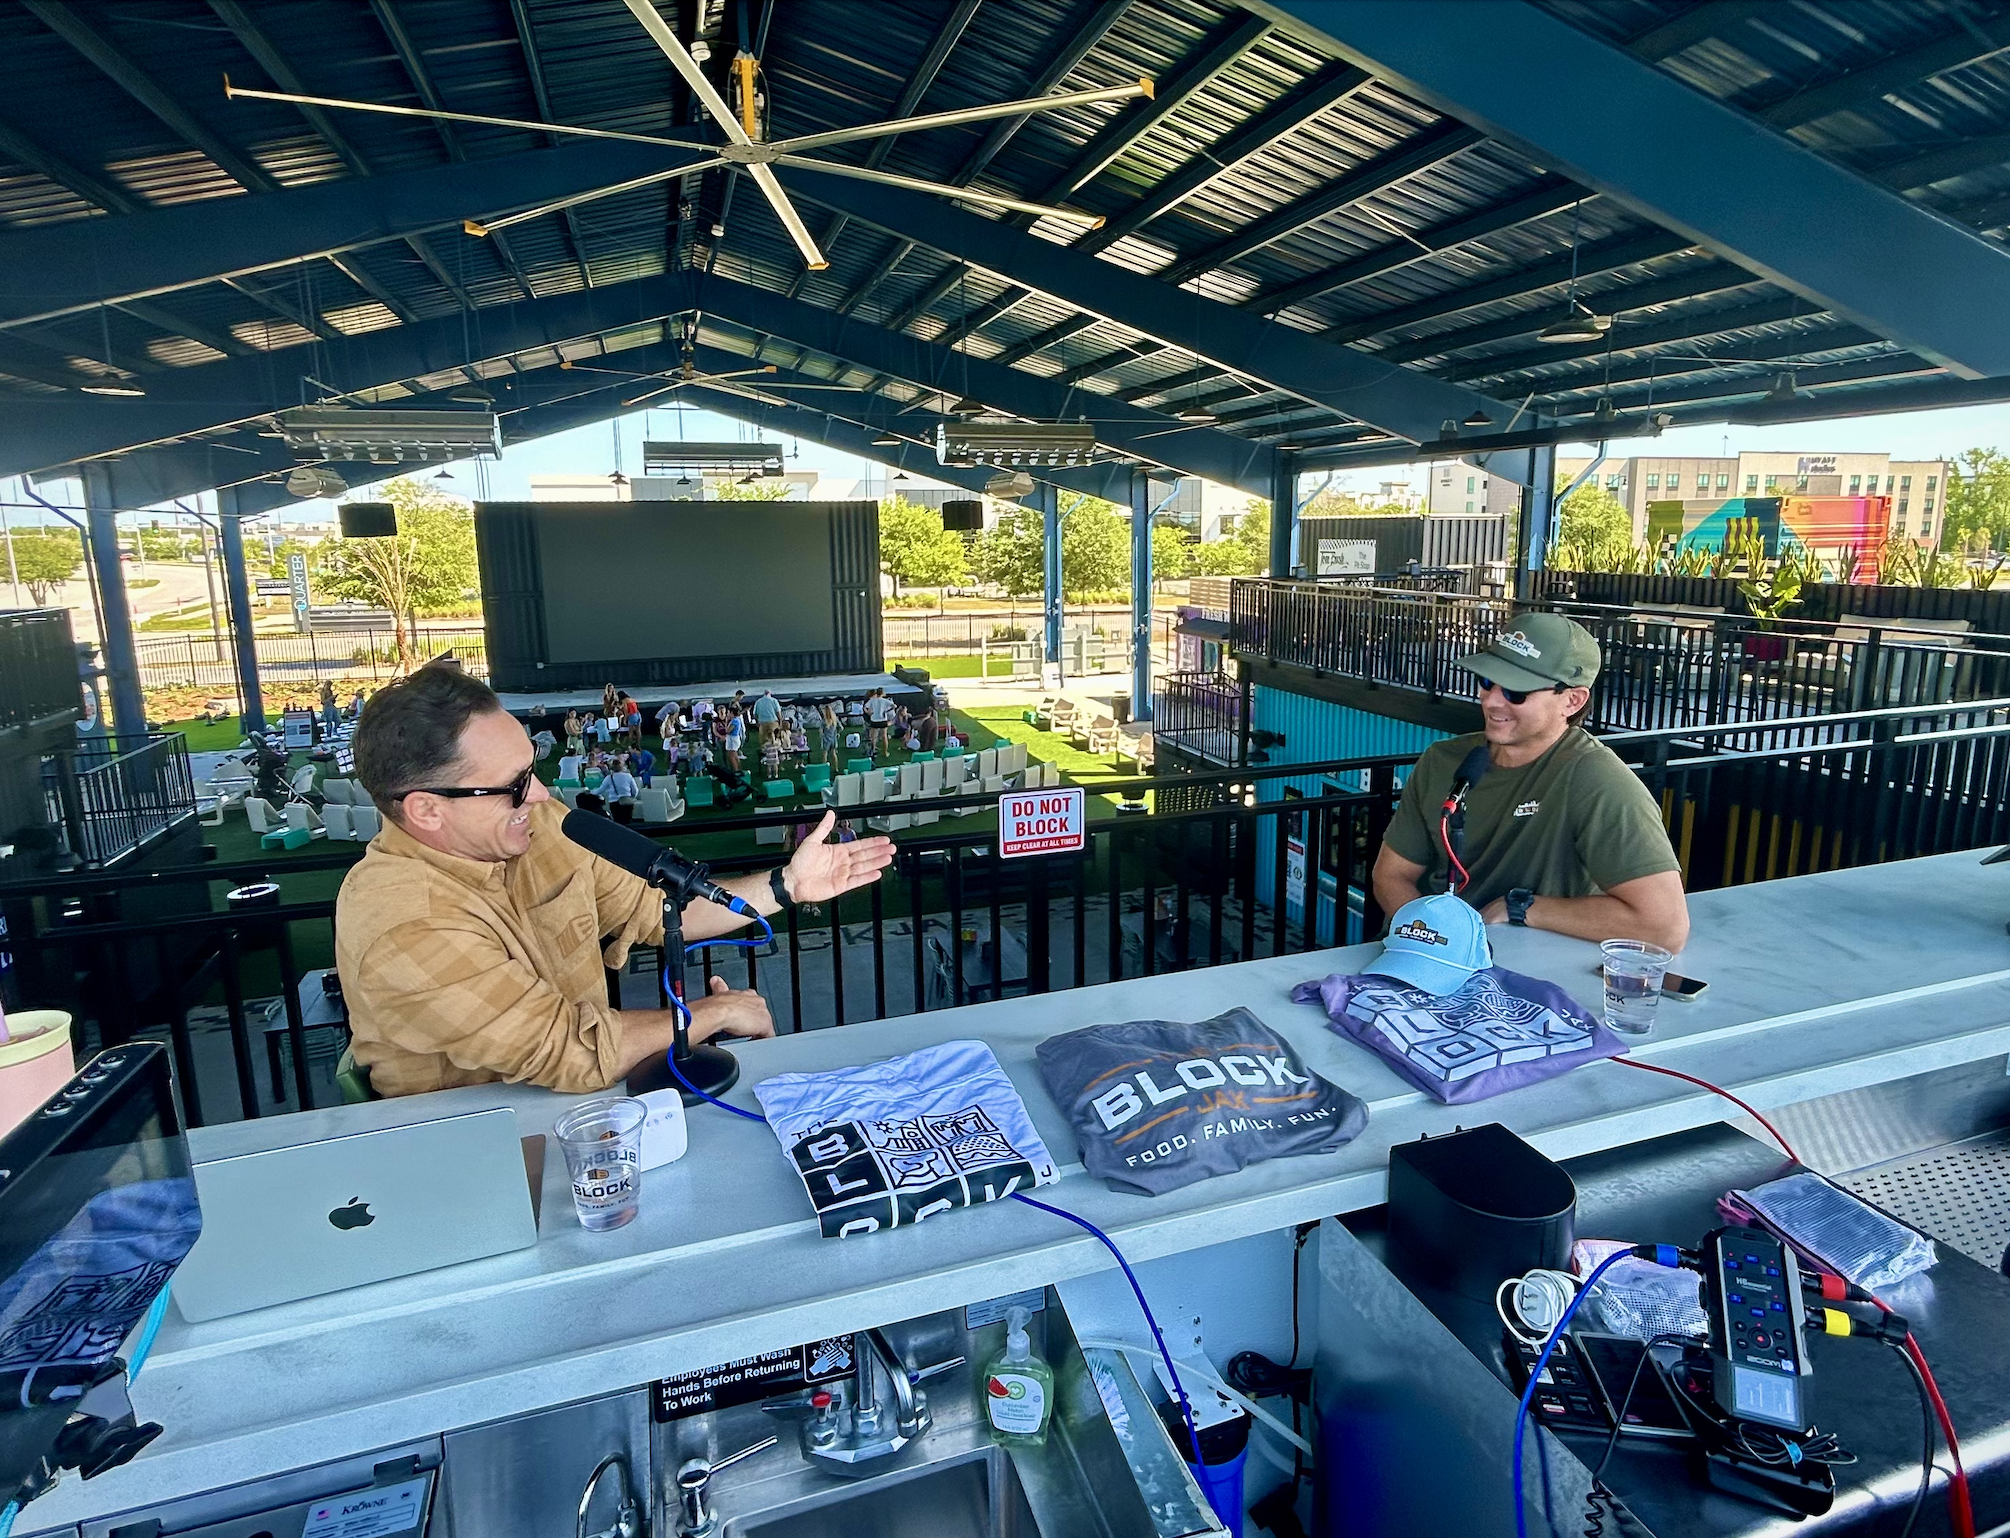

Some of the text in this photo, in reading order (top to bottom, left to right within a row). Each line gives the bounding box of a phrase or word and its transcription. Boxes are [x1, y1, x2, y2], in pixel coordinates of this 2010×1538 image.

[291, 555, 307, 612] QUARTER
[1502, 635, 1531, 652] BLOCK
[1012, 797, 1072, 817] DO NOT
[1015, 817, 1069, 837] BLOCK
[1006, 837, 1078, 852] KEEP CLEAR AT ALL TIMES
[1401, 926, 1437, 941] BLOCK
[1561, 1008, 1594, 1031] JAX
[1092, 1055, 1310, 1131] BLOCK
[1196, 1089, 1251, 1114] JAX
[1125, 1107, 1337, 1167] FOOD. FAMILY. FUN.
[573, 1177, 631, 1197] BLOCK
[729, 1356, 758, 1369] Must
[760, 1348, 792, 1362] Wash
[1746, 1355, 1782, 1369] ZOOM
[662, 1359, 801, 1398] Hands Before Returning
[663, 1392, 712, 1411] To Work
